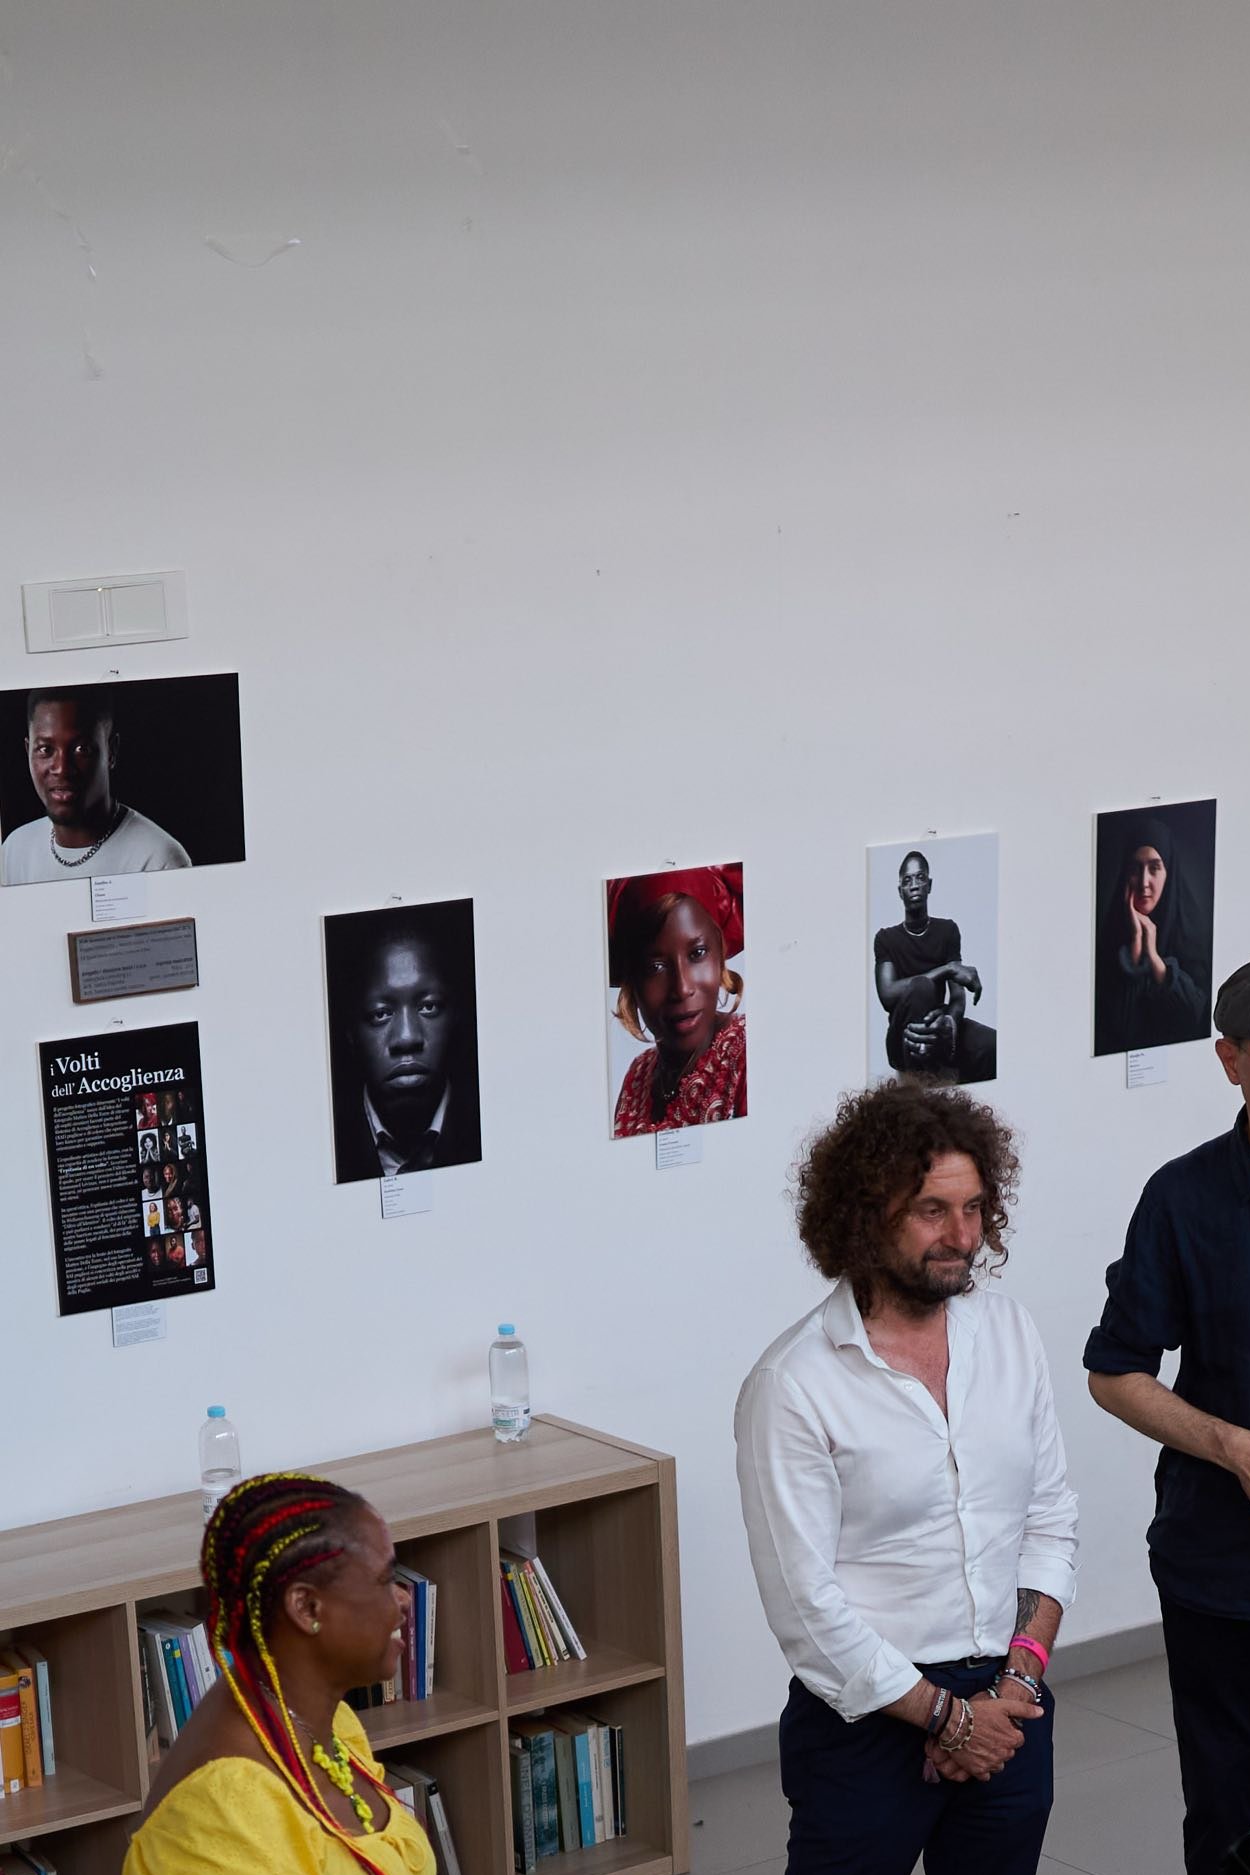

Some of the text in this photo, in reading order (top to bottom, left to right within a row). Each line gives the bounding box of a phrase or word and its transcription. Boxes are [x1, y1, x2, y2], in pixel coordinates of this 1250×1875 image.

[50, 1051, 101, 1076] i Volti
[51, 1066, 185, 1098] dell' Accoglienza
